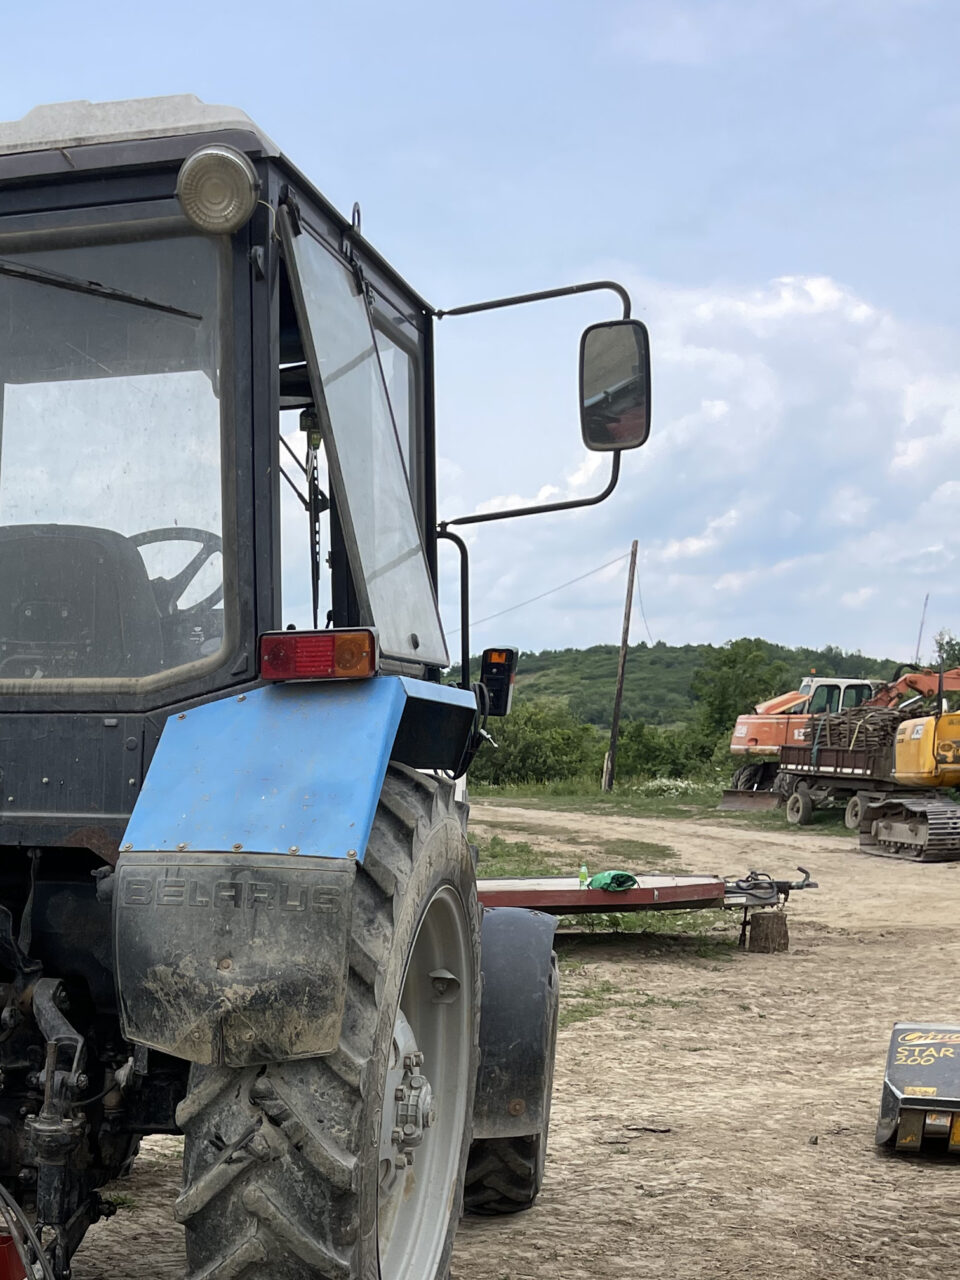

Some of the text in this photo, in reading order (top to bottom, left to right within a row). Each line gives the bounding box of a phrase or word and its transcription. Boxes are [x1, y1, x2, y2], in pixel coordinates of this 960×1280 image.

[123, 878, 341, 914] BELARUS
[895, 1046, 955, 1057] STAR
[894, 1056, 935, 1066] 200
